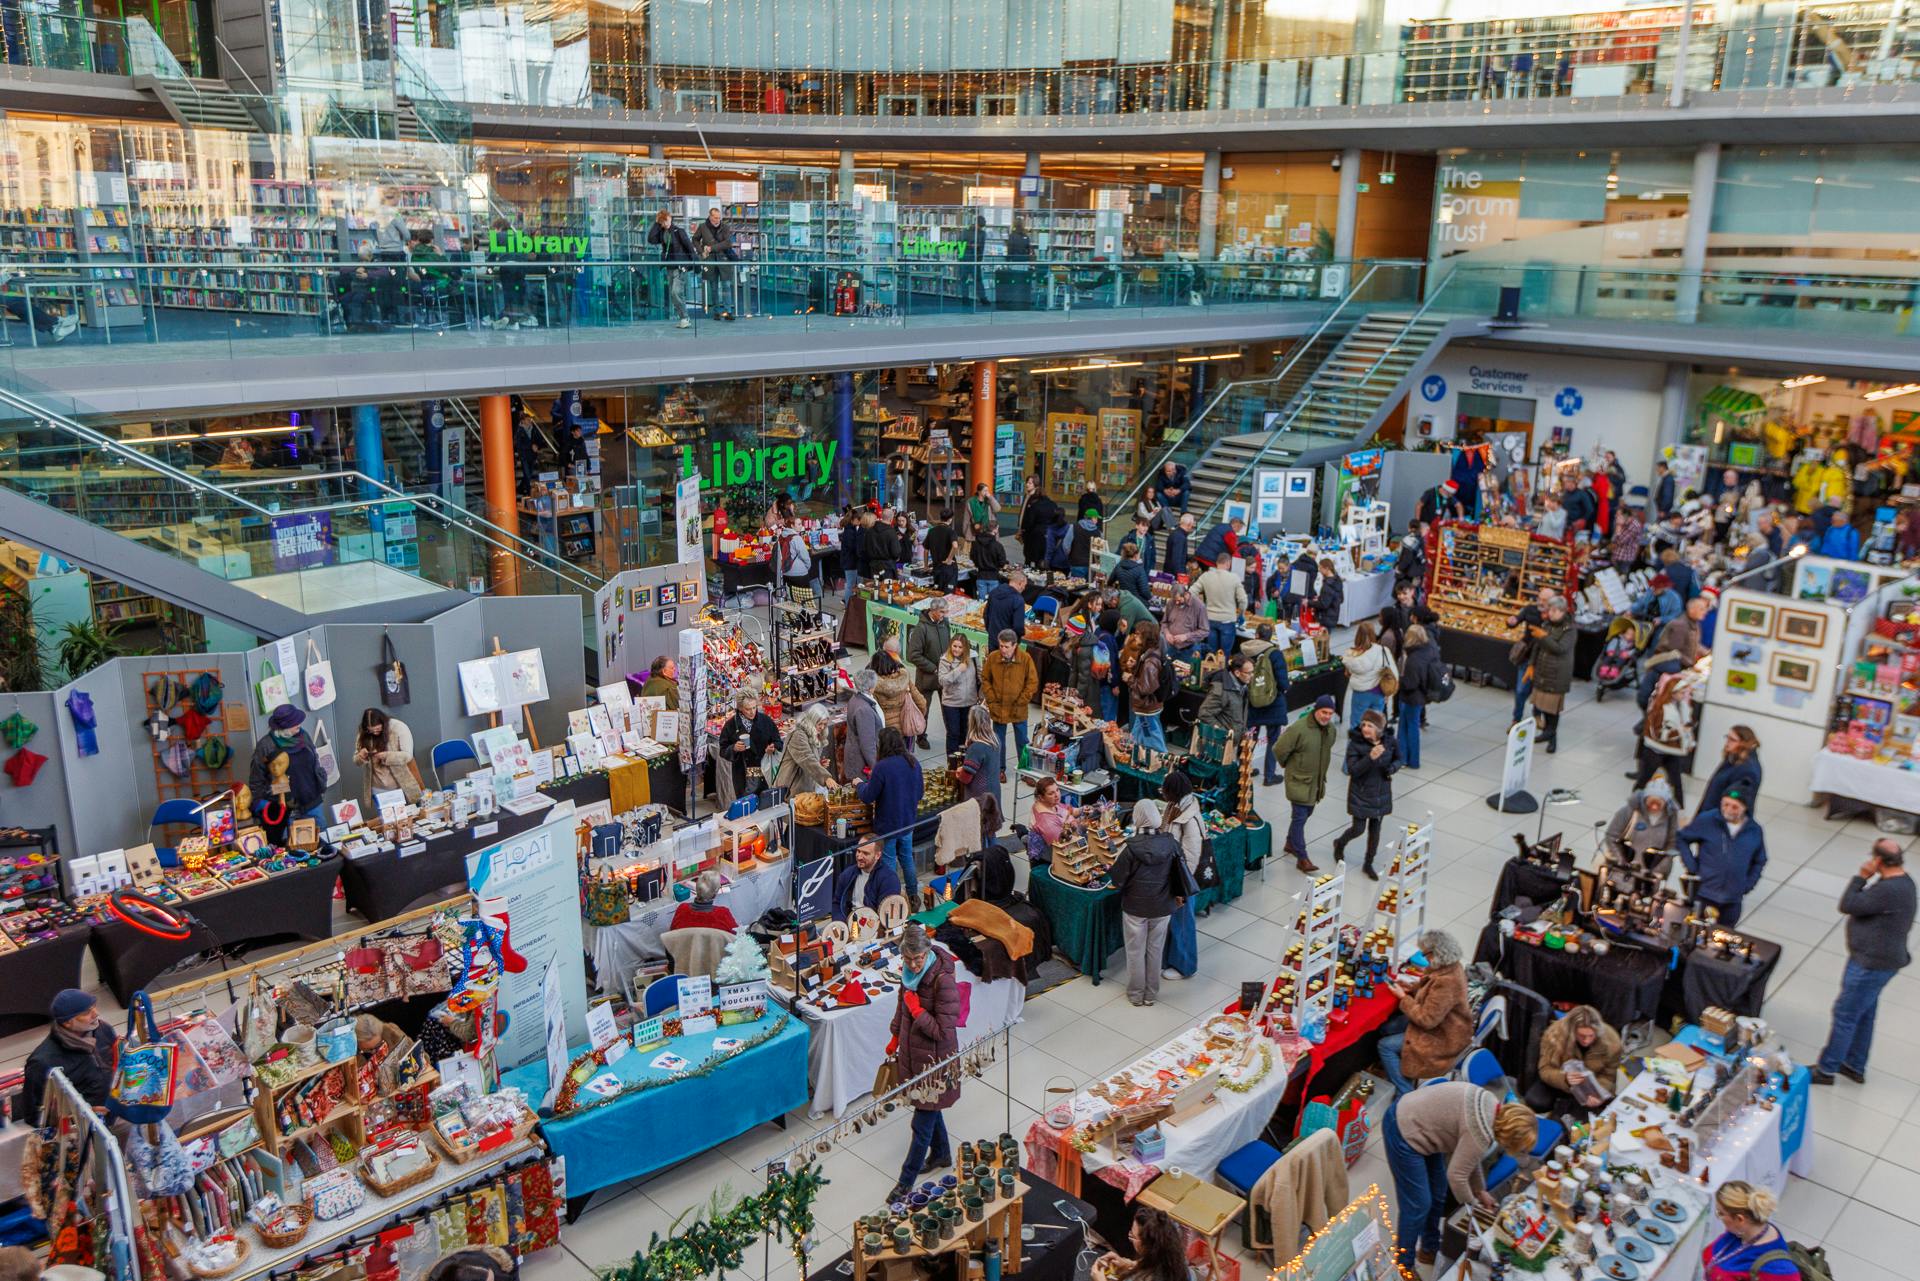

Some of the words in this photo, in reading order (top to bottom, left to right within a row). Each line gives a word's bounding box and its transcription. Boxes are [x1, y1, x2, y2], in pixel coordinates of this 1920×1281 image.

[1441, 166, 1482, 189] The
[1439, 193, 1513, 216] Forum
[1437, 221, 1487, 242] Trust
[488, 229, 589, 259] Library
[902, 235, 967, 259] Library
[1469, 365, 1528, 381] Customer
[981, 368, 992, 400] Library
[1471, 379, 1523, 394] Services
[683, 440, 838, 489] Library
[276, 522, 321, 539] NORWICH
[277, 532, 317, 547] SCIENCE
[278, 541, 325, 558] FESTIVAL
[493, 834, 549, 872] FLOAT
[508, 894, 522, 905] LOAT
[515, 933, 547, 952] YOTHERAPY
[727, 986, 750, 996] XMAS
[513, 991, 541, 1010] INFRARED
[721, 994, 766, 1007] VOUCHERS
[638, 1026, 659, 1036] FRIDAY
[639, 1020, 657, 1029] BLACK
[640, 1033, 658, 1043] DEALS
